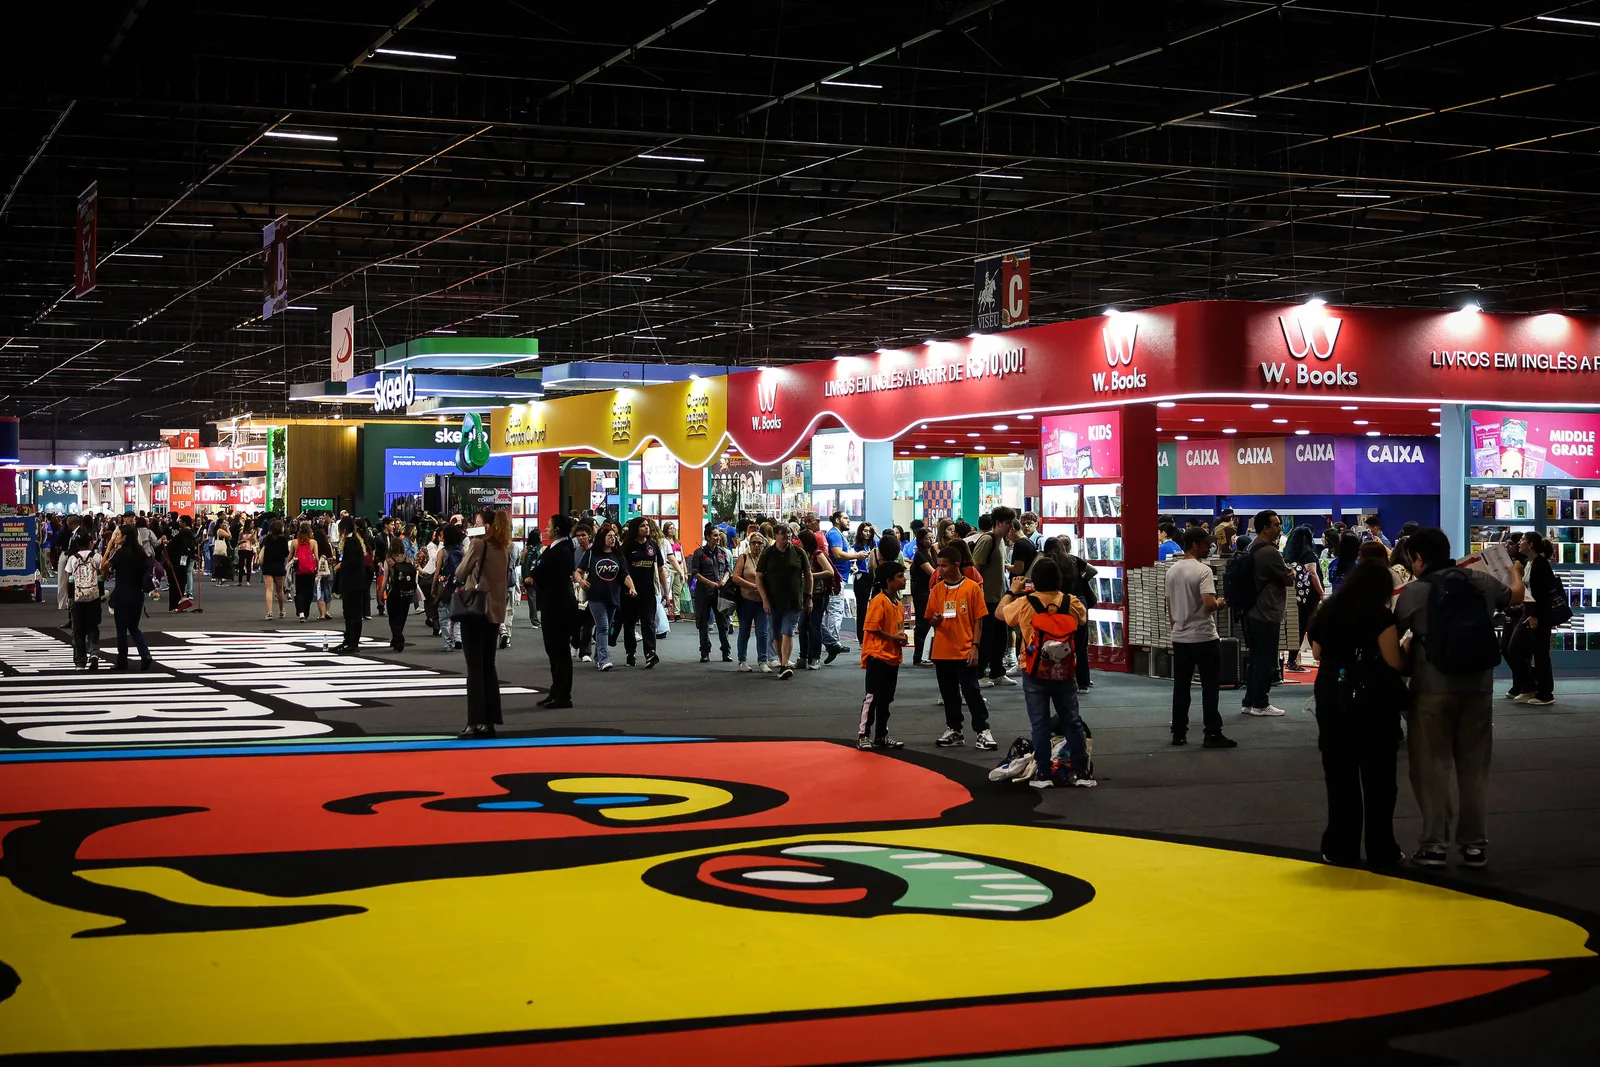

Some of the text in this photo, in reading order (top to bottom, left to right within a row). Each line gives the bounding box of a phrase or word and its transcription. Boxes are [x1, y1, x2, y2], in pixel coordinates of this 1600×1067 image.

[277, 242, 285, 291] B
[1009, 274, 1023, 319] C
[978, 314, 1000, 329] VISEU
[1432, 350, 1490, 368] LIVROS
[1494, 352, 1518, 369] EM
[1521, 351, 1578, 370] INGLÊS
[1580, 355, 1592, 370] A
[825, 376, 855, 397] LIVROS
[856, 374, 870, 393] EM
[871, 368, 905, 391] INGLÊS
[913, 364, 947, 386] PARTIR
[949, 363, 964, 382] DE
[1092, 367, 1147, 392] W. Books
[1262, 362, 1358, 386] W. Books
[374, 365, 415, 412] skeelo
[751, 413, 782, 431] W. Books
[1088, 423, 1113, 441] KIDS
[1549, 430, 1595, 443] MIDDLE
[1186, 449, 1220, 466] CAIXA
[1236, 447, 1273, 465] CAIXA
[1295, 443, 1334, 462] CAIXA
[1366, 445, 1425, 463] CAIXA
[1551, 443, 1594, 457] GRADE
[172, 486, 192, 495] LIVRO
